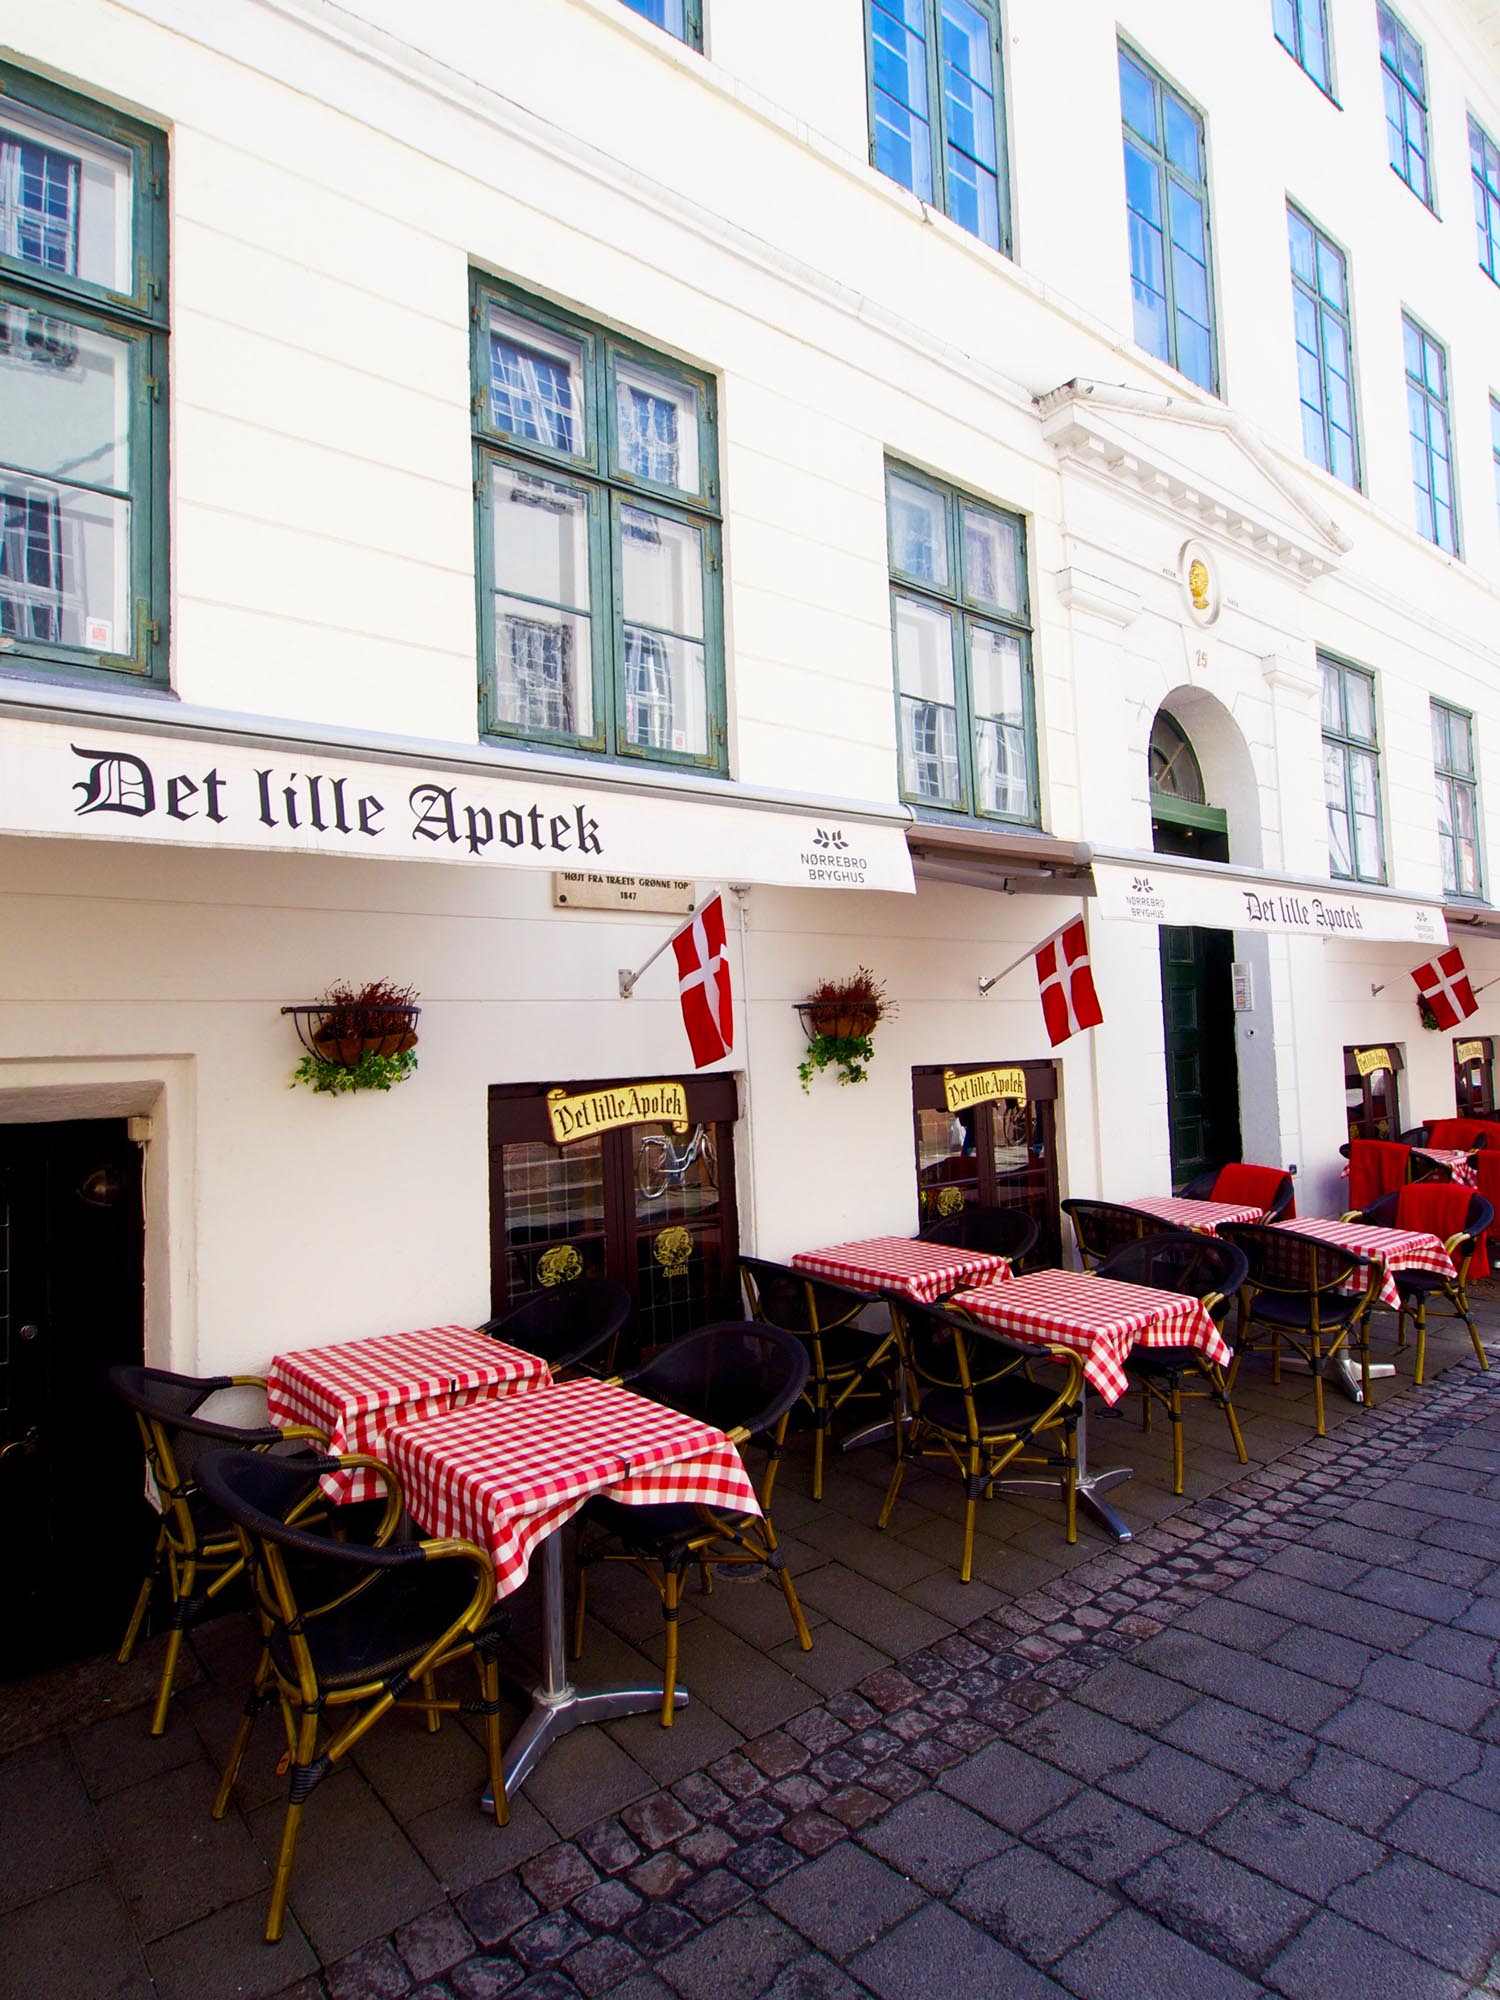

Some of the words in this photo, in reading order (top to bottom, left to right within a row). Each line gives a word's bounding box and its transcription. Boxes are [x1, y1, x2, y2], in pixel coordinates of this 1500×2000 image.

[70, 743, 228, 824] Det
[253, 768, 386, 836] lille
[408, 783, 605, 856] Apotek
[800, 853, 867, 869] NØRREBRO
[588, 874, 603, 883] FRA
[606, 876, 635, 886] TRÆETS
[639, 878, 671, 888] GRØNNE
[808, 869, 865, 883] BRYGHUS
[620, 891, 637, 900] 1847
[1242, 890, 1276, 922] Det
[1279, 896, 1310, 925] lille
[1312, 898, 1363, 931] Apotek
[948, 1081, 969, 1108] Det
[970, 1076, 990, 1098] lille
[990, 1072, 1023, 1096] Apotek
[553, 1100, 591, 1137] Det
[592, 1094, 626, 1122] lille
[626, 1088, 682, 1119] Apotek
